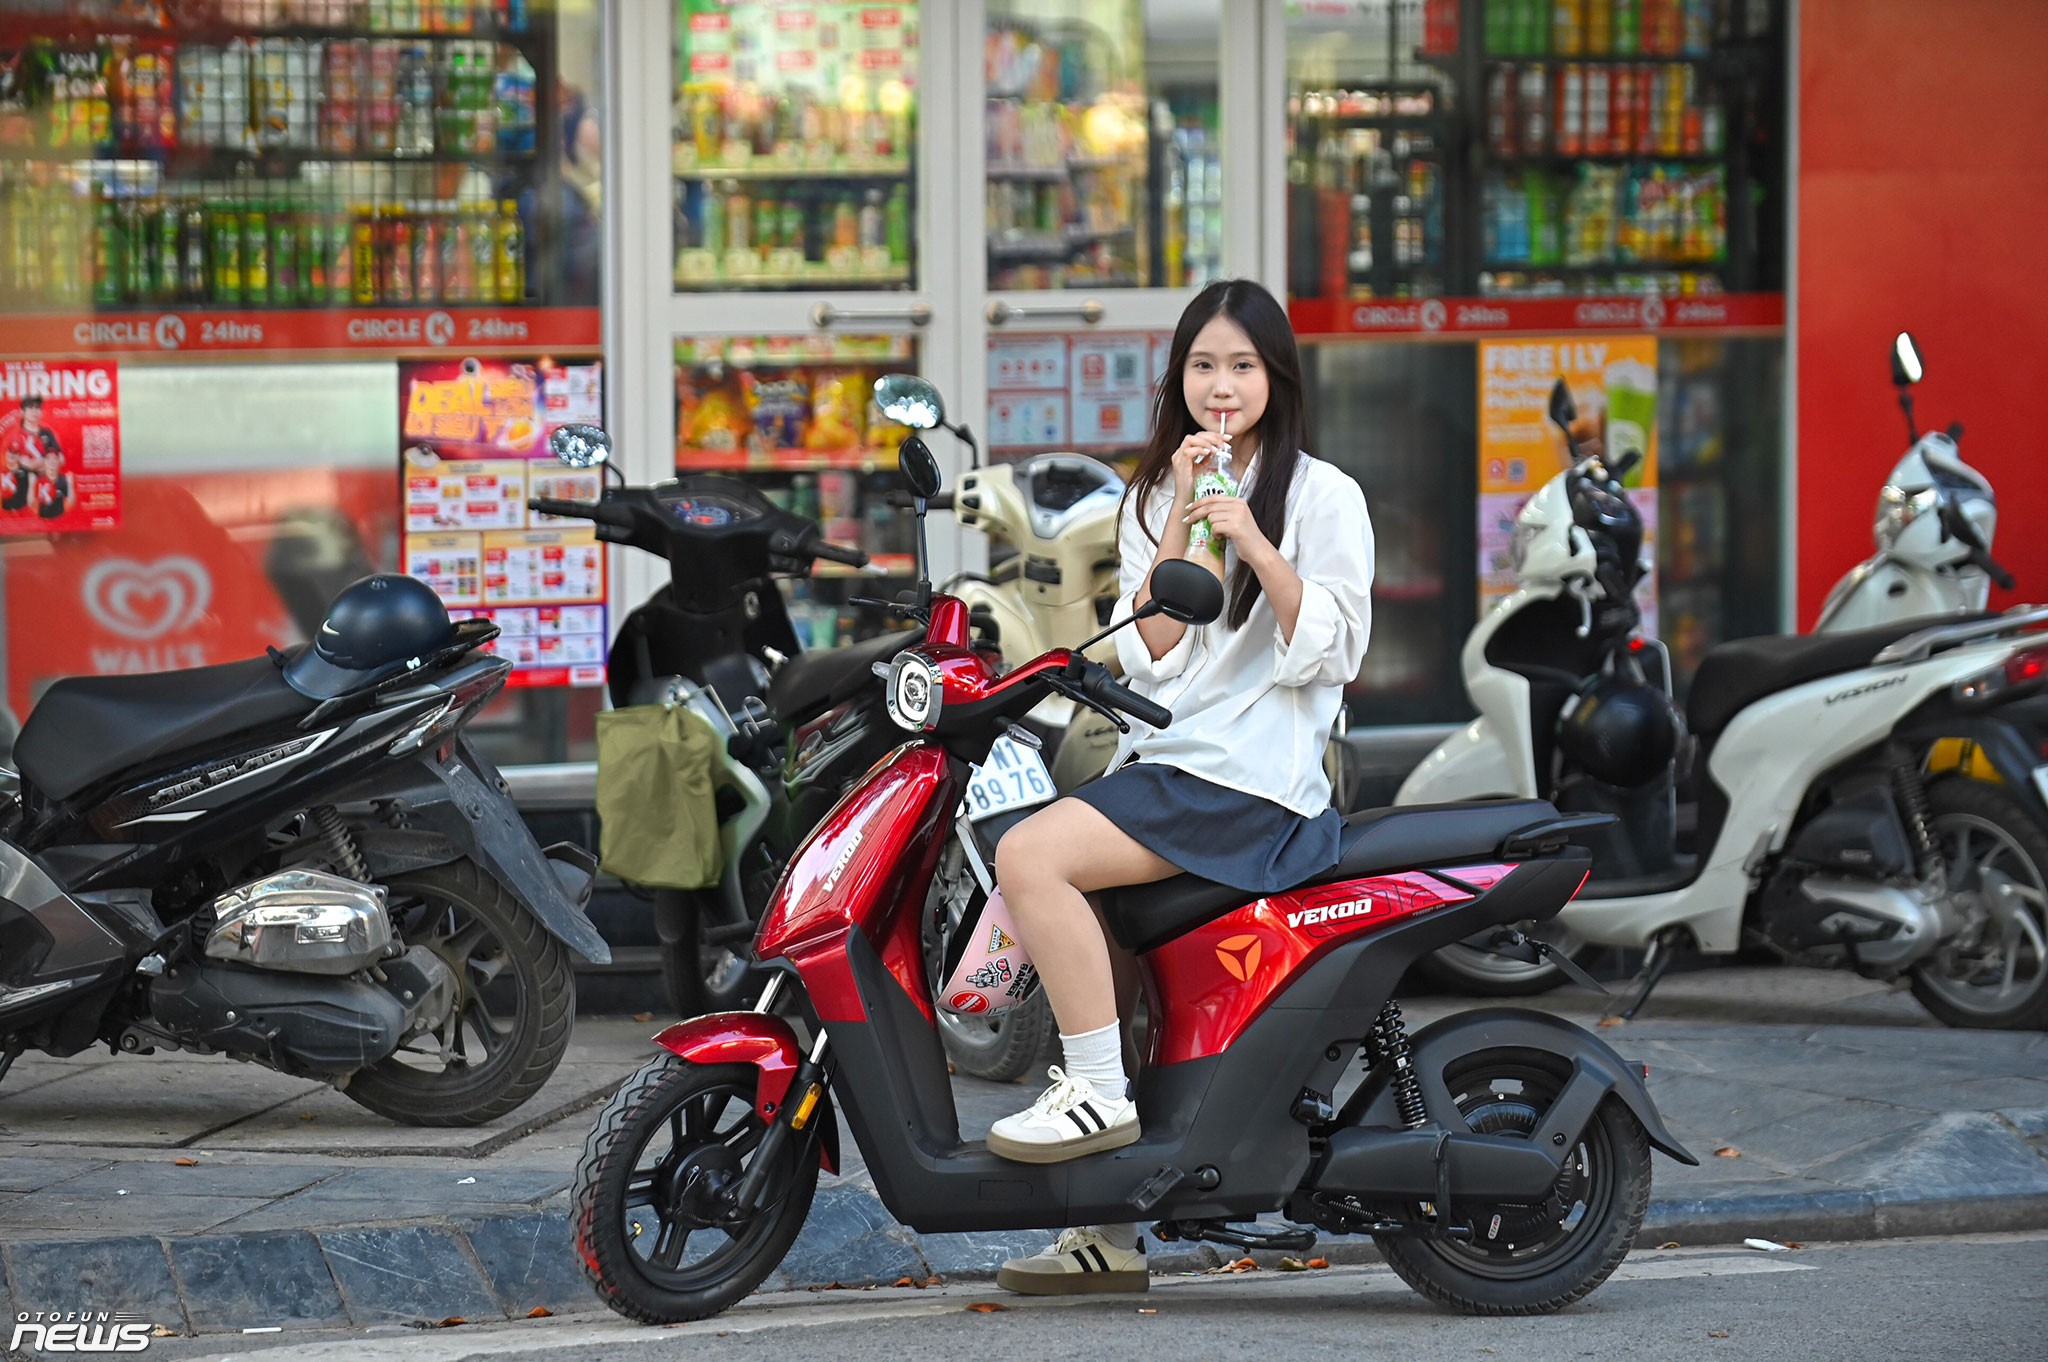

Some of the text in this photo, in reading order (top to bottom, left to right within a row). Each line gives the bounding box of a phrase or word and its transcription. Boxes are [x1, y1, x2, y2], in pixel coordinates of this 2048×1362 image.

[1355, 306, 1416, 324] CIRCLE
[1455, 304, 1509, 323] 24hrs
[1577, 302, 1636, 321] CIRCLE
[73, 314, 263, 350] CIRCLE K 24hrs
[347, 311, 528, 345] CIRCLE K 24hrs
[1486, 343, 1555, 372] FREE
[0, 368, 112, 399] HIRING
[1823, 673, 1909, 706] VISION
[969, 767, 1045, 814] 89.76
[822, 831, 864, 893] VEKOO
[1286, 898, 1373, 929] VEKOO
